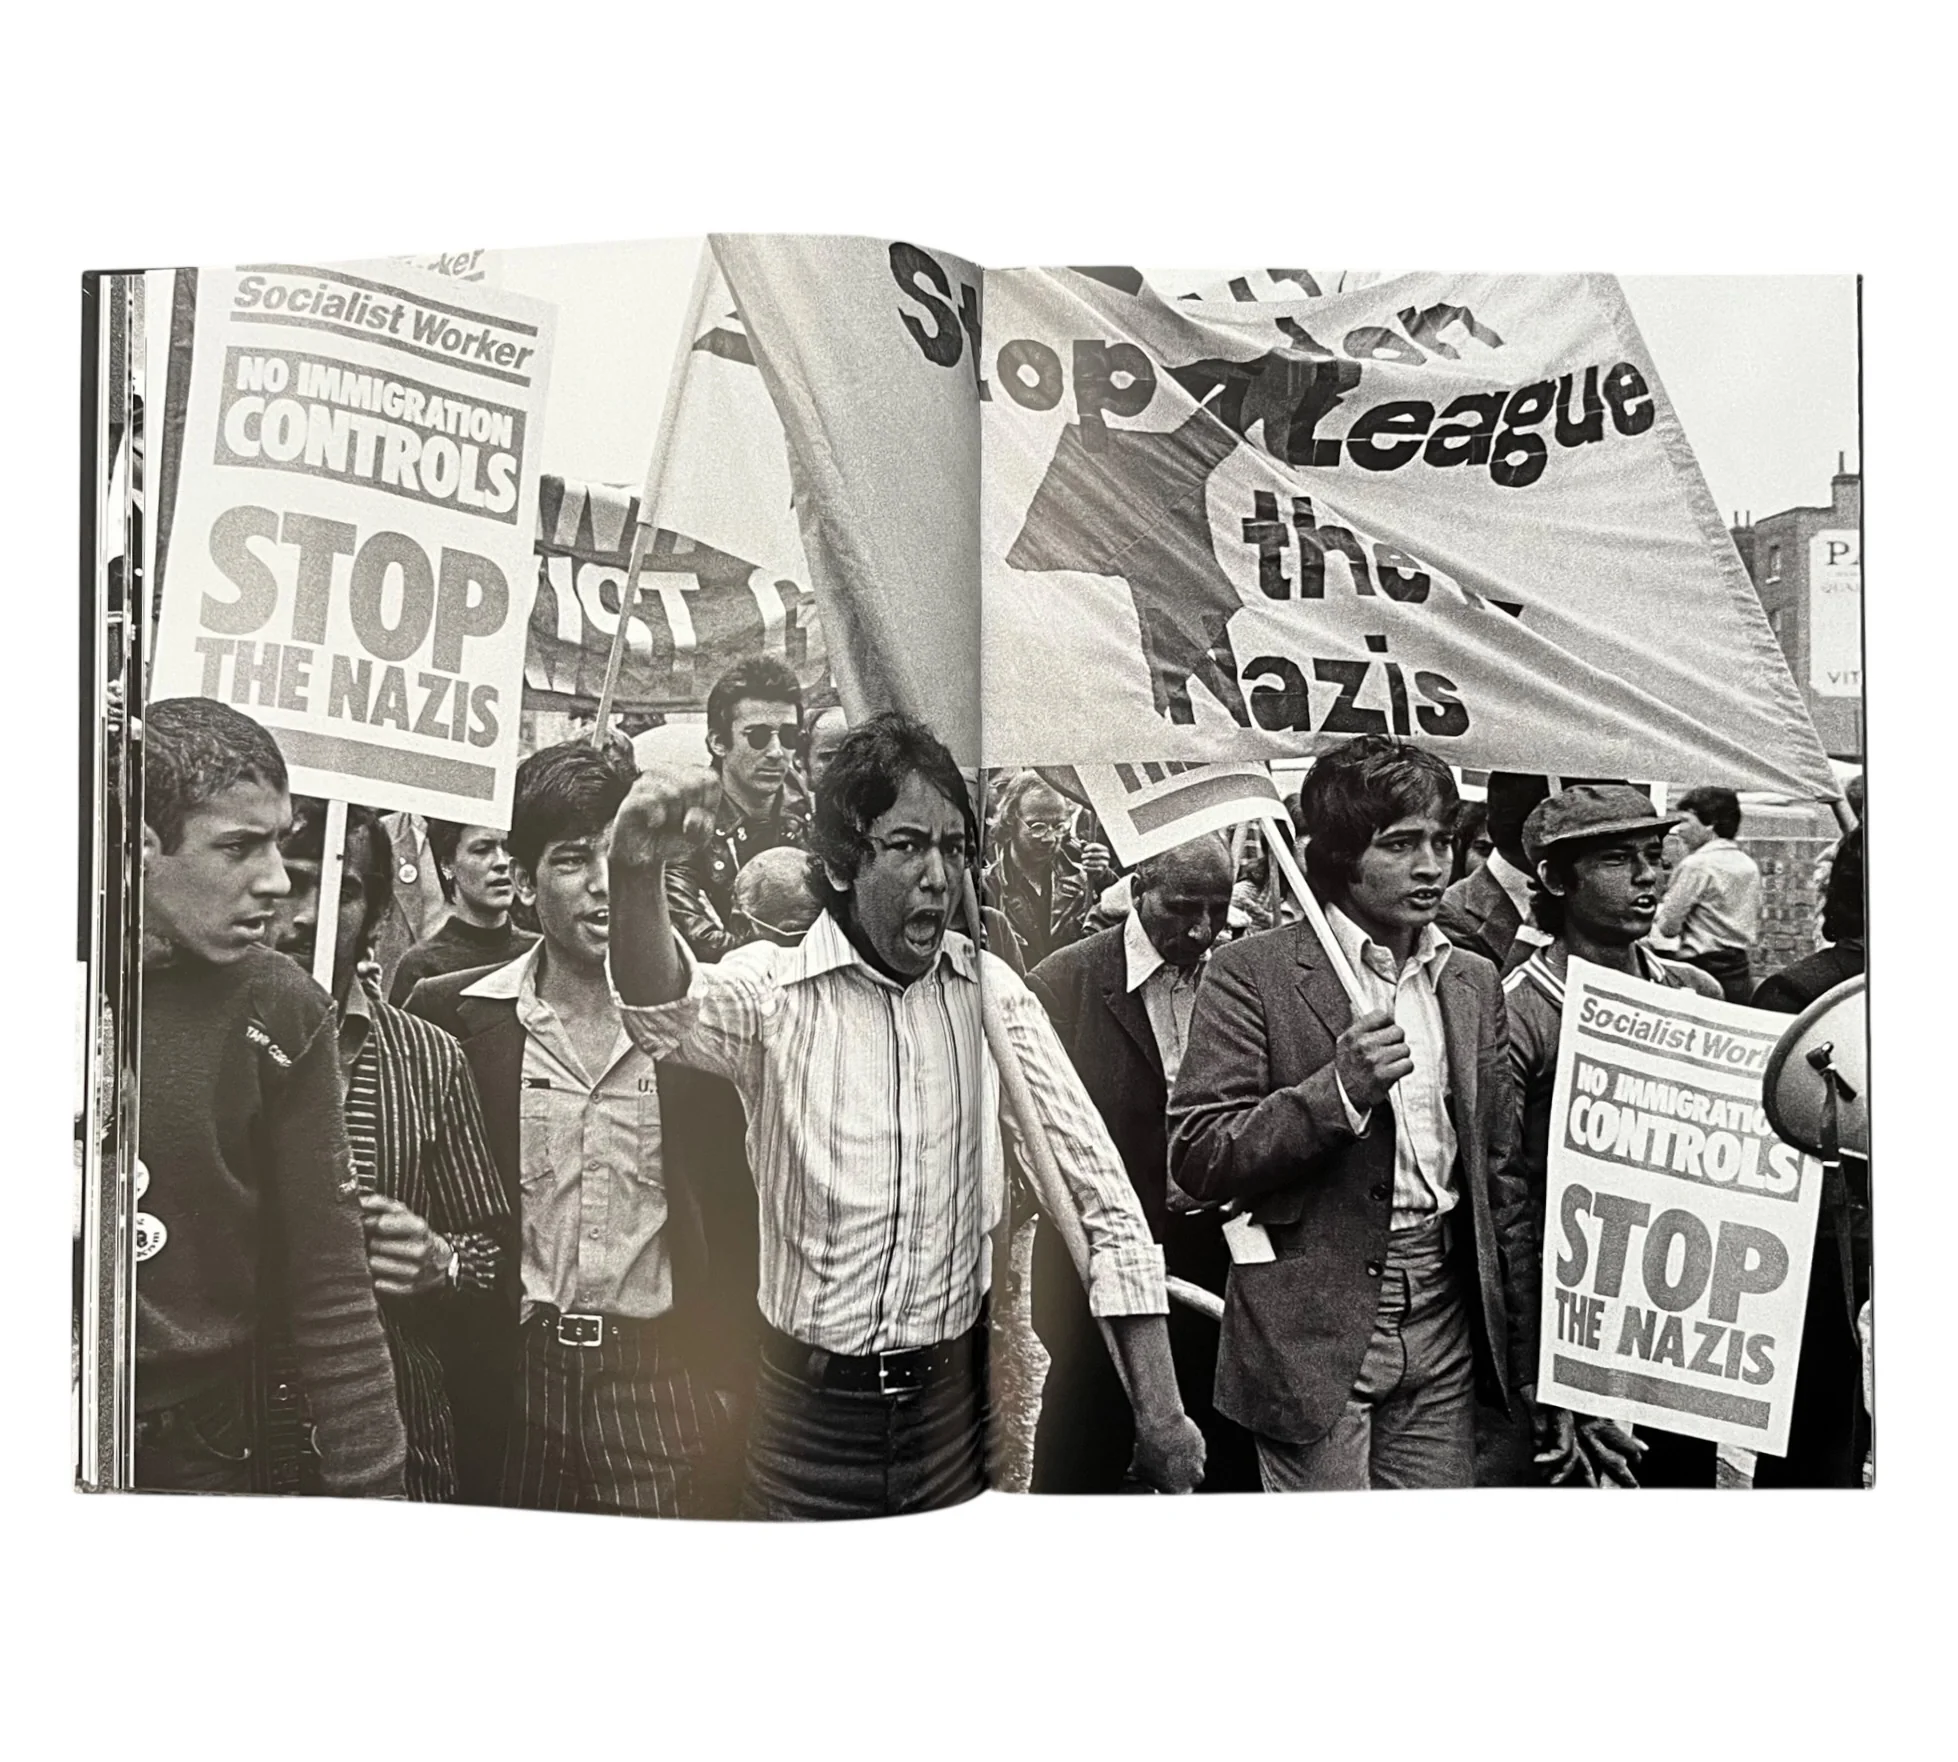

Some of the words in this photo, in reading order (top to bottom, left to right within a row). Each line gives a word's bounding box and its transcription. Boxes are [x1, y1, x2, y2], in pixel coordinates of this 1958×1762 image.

[428, 249, 485, 276] ker
[234, 275, 406, 337] Socialist
[410, 310, 534, 372] Worker
[237, 355, 290, 393] NO
[296, 361, 513, 449] IMMIGRATION
[223, 396, 518, 514] CONTROLS
[198, 505, 510, 676] STOP
[1241, 489, 1431, 604] the
[1826, 541, 1859, 566] P
[195, 637, 313, 712] THE
[328, 653, 500, 748] NAZIS
[1140, 607, 1470, 737] Nazis
[1580, 997, 1697, 1051] Socialist
[1568, 1095, 1800, 1194] CONTROLS
[1577, 1067, 1607, 1098] NO
[1613, 1071, 1780, 1139] IMMIGRATIO
[1556, 1183, 1790, 1323] STOP
[1554, 1287, 1606, 1351] THE
[1617, 1305, 1777, 1386] NAZIS
